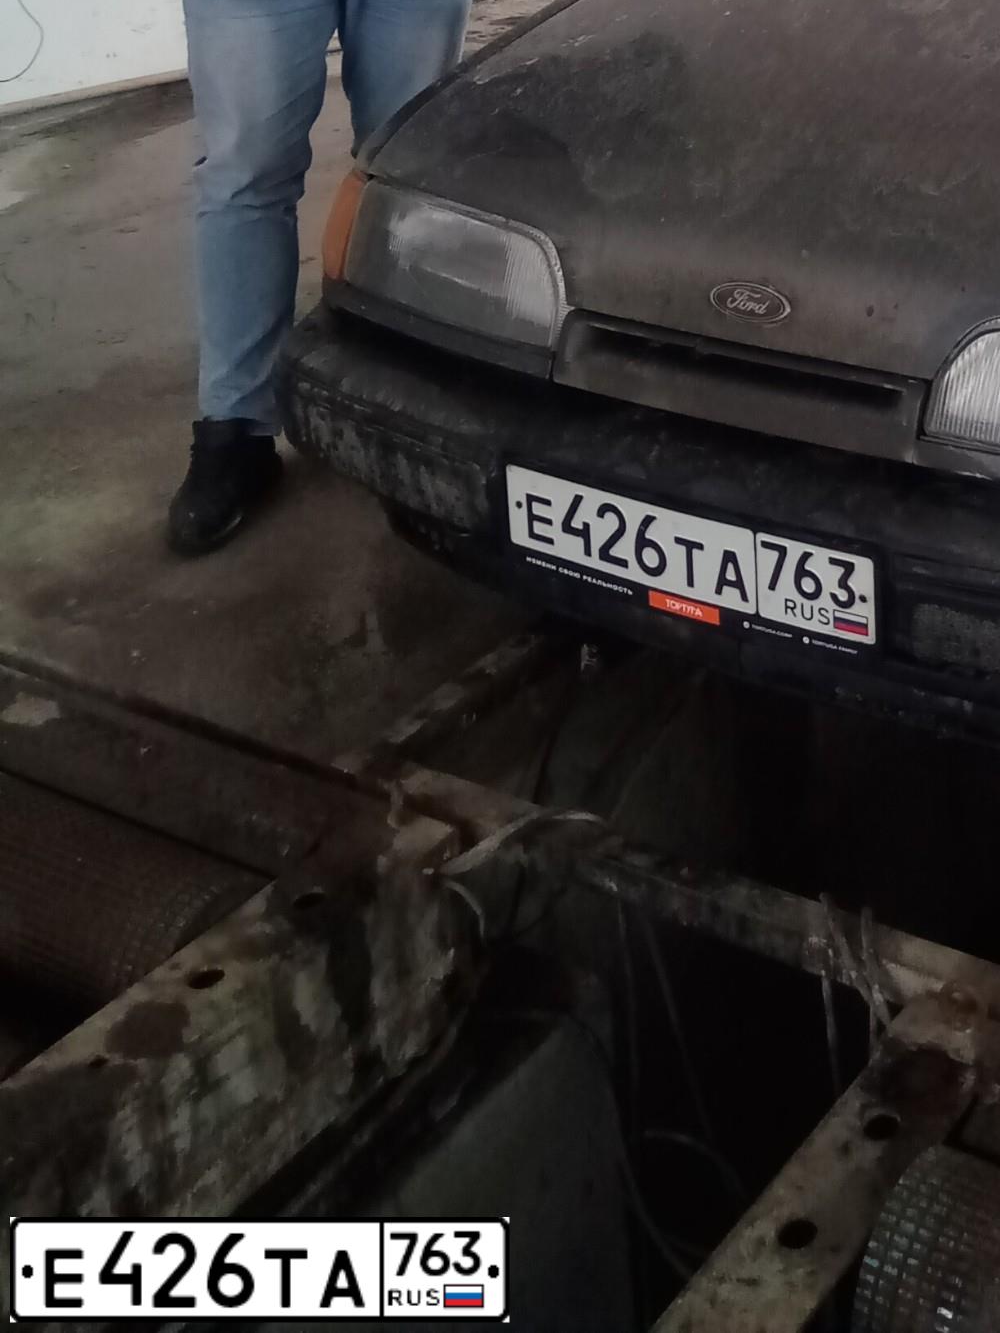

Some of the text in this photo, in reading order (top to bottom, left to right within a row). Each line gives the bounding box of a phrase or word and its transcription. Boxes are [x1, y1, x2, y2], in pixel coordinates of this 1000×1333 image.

[726, 288, 771, 315] Ford
[525, 492, 857, 610] Е426ТА 763
[558, 567, 581, 579] СВОЮ
[582, 575, 634, 596] РЕАЛЬНОСТЬ
[784, 598, 831, 626] RUS
